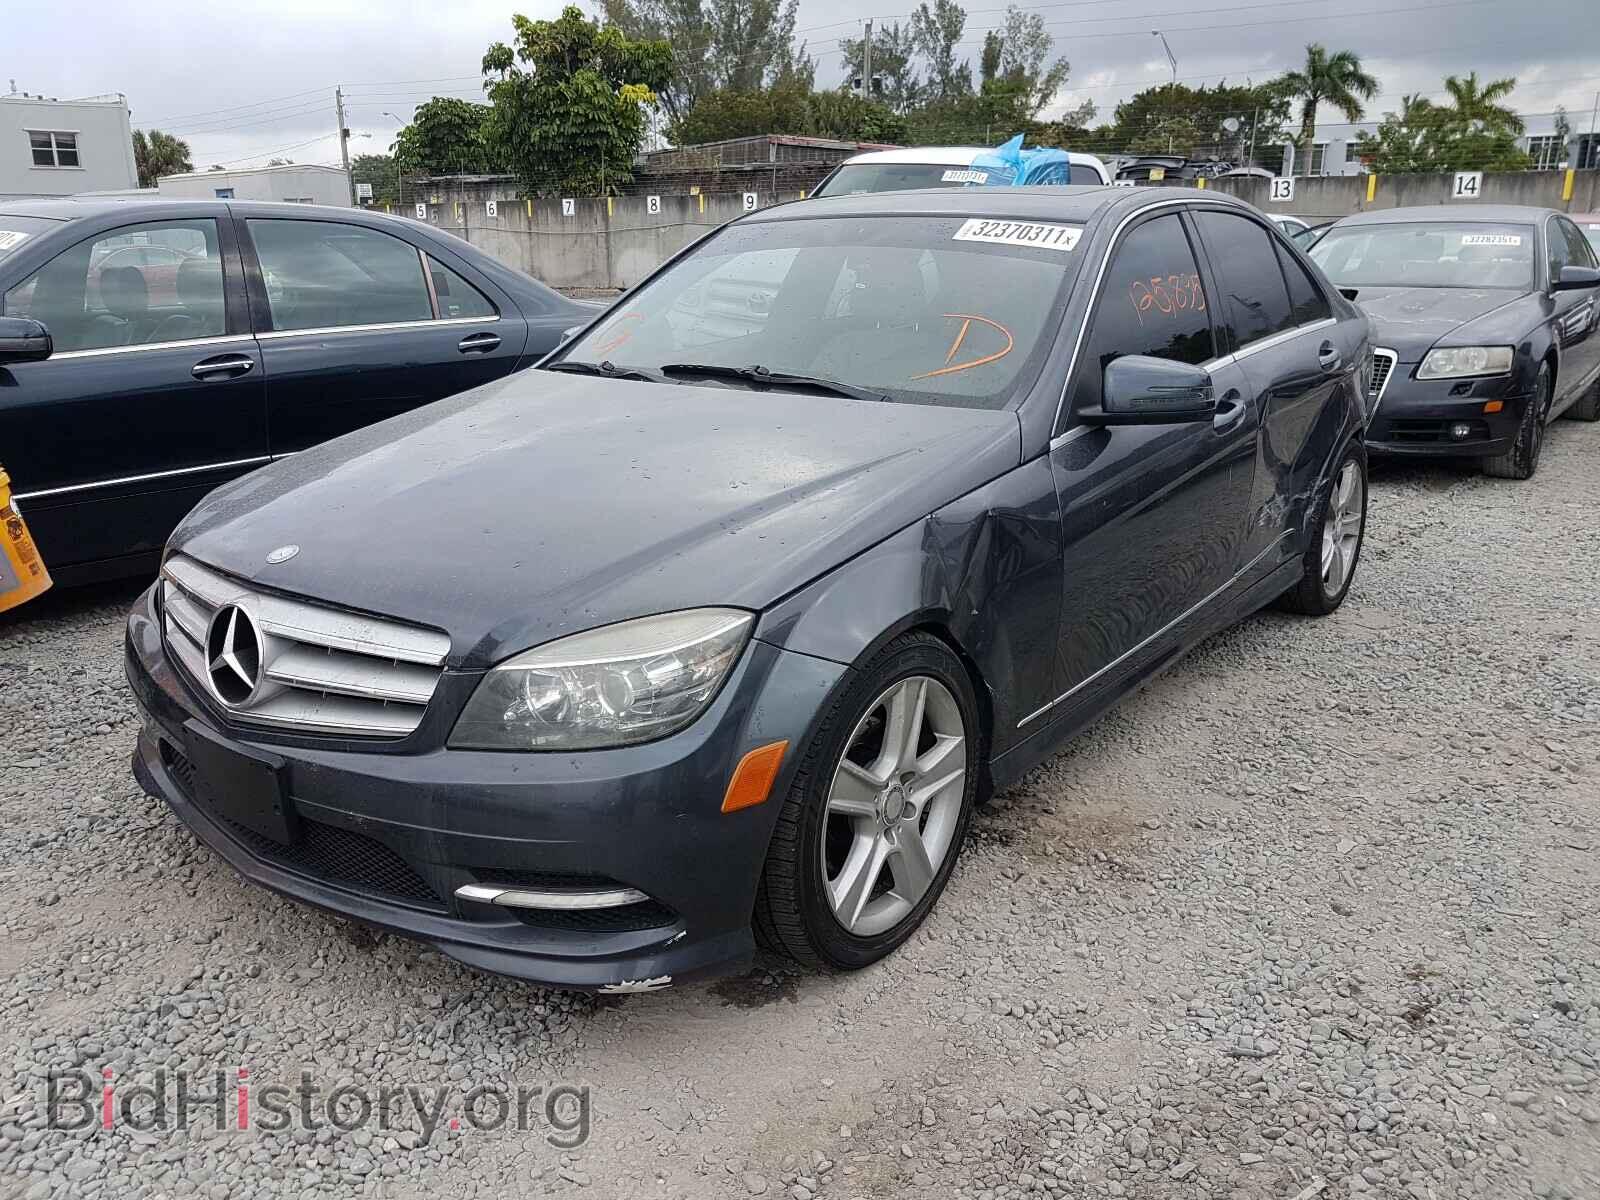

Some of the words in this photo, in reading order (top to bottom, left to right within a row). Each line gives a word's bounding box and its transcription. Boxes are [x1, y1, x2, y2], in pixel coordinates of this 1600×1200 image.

[1272, 180, 1291, 198] 13
[1456, 175, 1478, 195] 14
[565, 201, 572, 213] 7
[650, 198, 658, 211] 8
[746, 195, 754, 209] 9
[418, 205, 425, 217] 5
[488, 203, 495, 215] 6
[912, 313, 1014, 381] D
